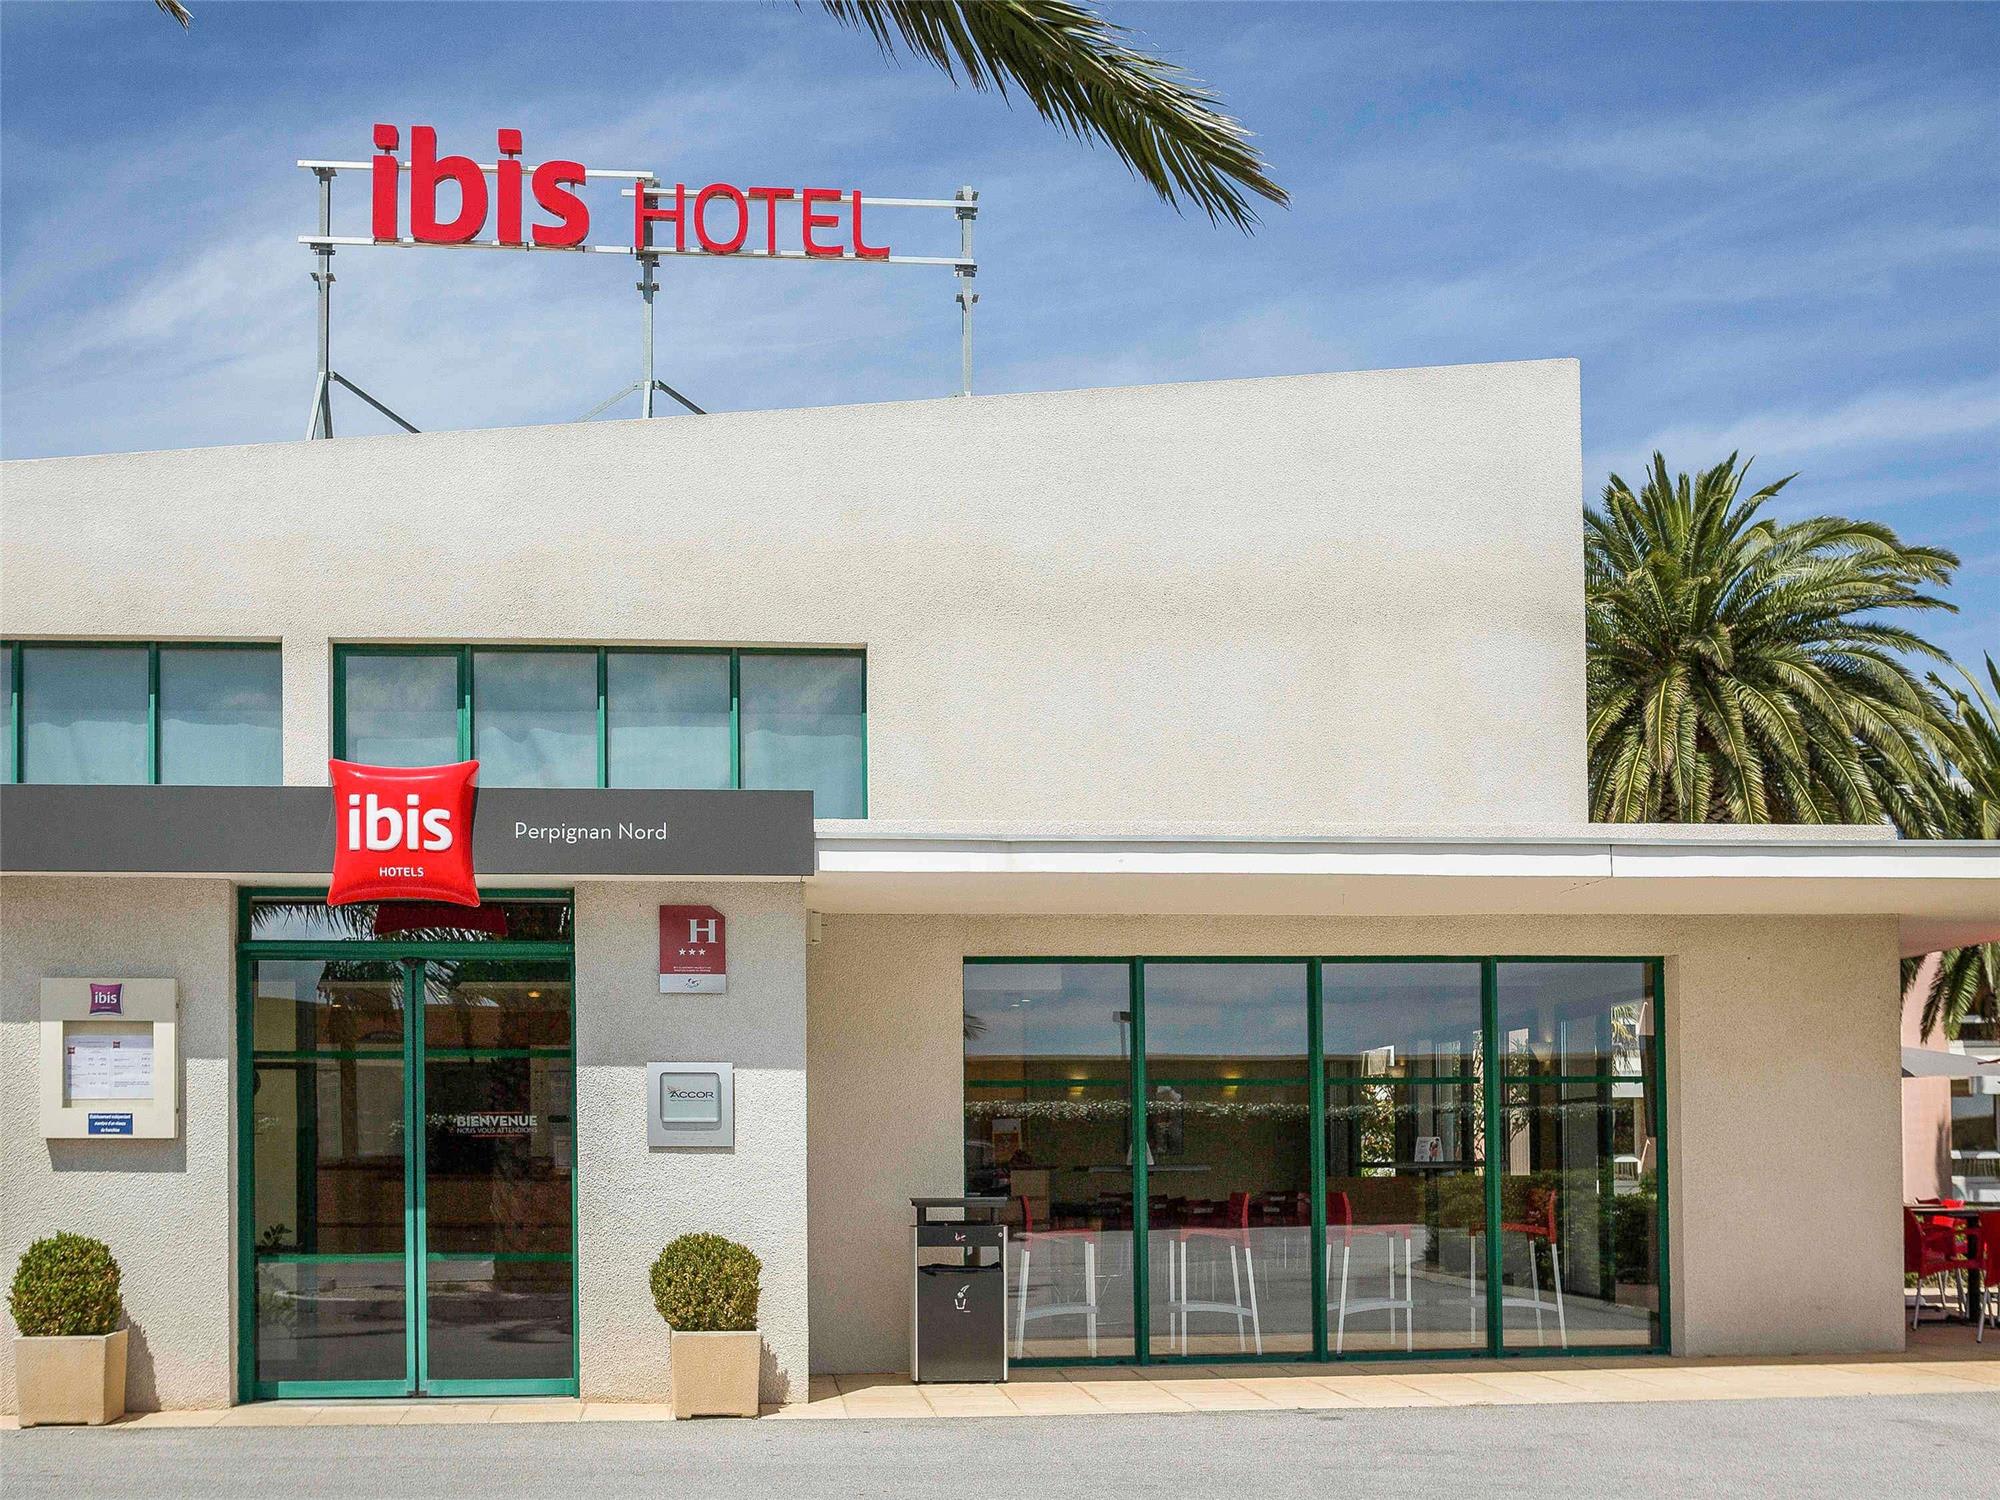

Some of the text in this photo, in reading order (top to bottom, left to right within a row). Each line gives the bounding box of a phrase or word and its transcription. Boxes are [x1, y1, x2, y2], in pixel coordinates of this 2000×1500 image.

[372, 124, 890, 259] ibis HOTEL
[348, 793, 453, 851] ibis
[515, 821, 667, 844] Perpignan Nord
[379, 866, 424, 877] HOTELS
[688, 919, 718, 943] H
[94, 991, 117, 1004] ibis
[456, 1115, 537, 1126] BIENVENUE
